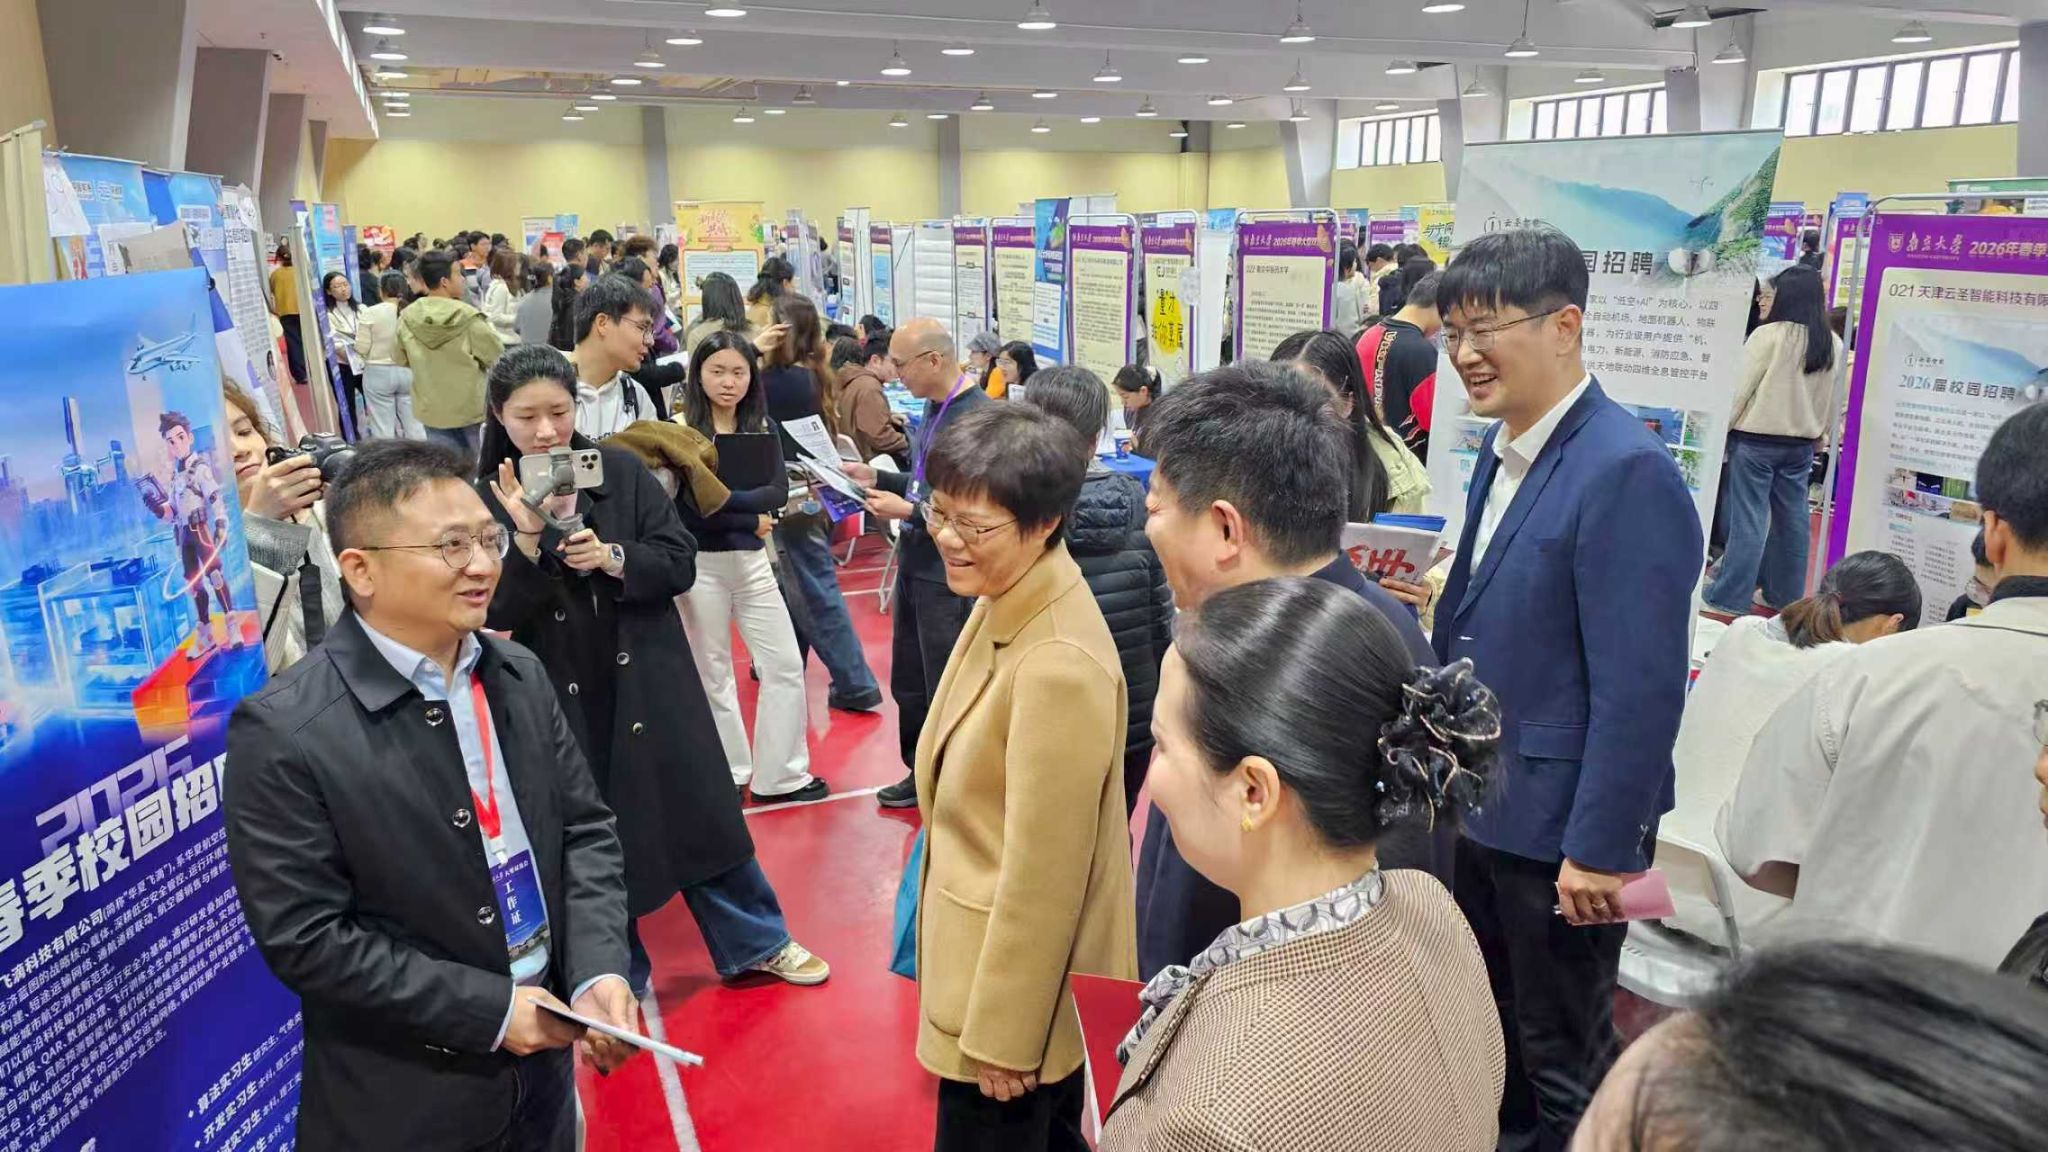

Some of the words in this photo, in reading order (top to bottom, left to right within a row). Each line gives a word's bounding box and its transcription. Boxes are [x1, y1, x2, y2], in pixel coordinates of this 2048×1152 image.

[1581, 250, 1653, 275] 园招聘
[1906, 232, 1963, 254] 南京大学
[1969, 241, 2048, 257] 2026年春季
[1889, 284, 1914, 297] 021
[1918, 285, 2048, 307] 天津云圣智能科技有限
[35, 734, 193, 857] 2026
[0, 751, 227, 951] 春季校园招
[504, 880, 522, 925] 工作证
[197, 1053, 252, 1115] 算法实习生
[203, 1080, 258, 1145] 开发实习生
[217, 1109, 262, 1152] 试实习生
